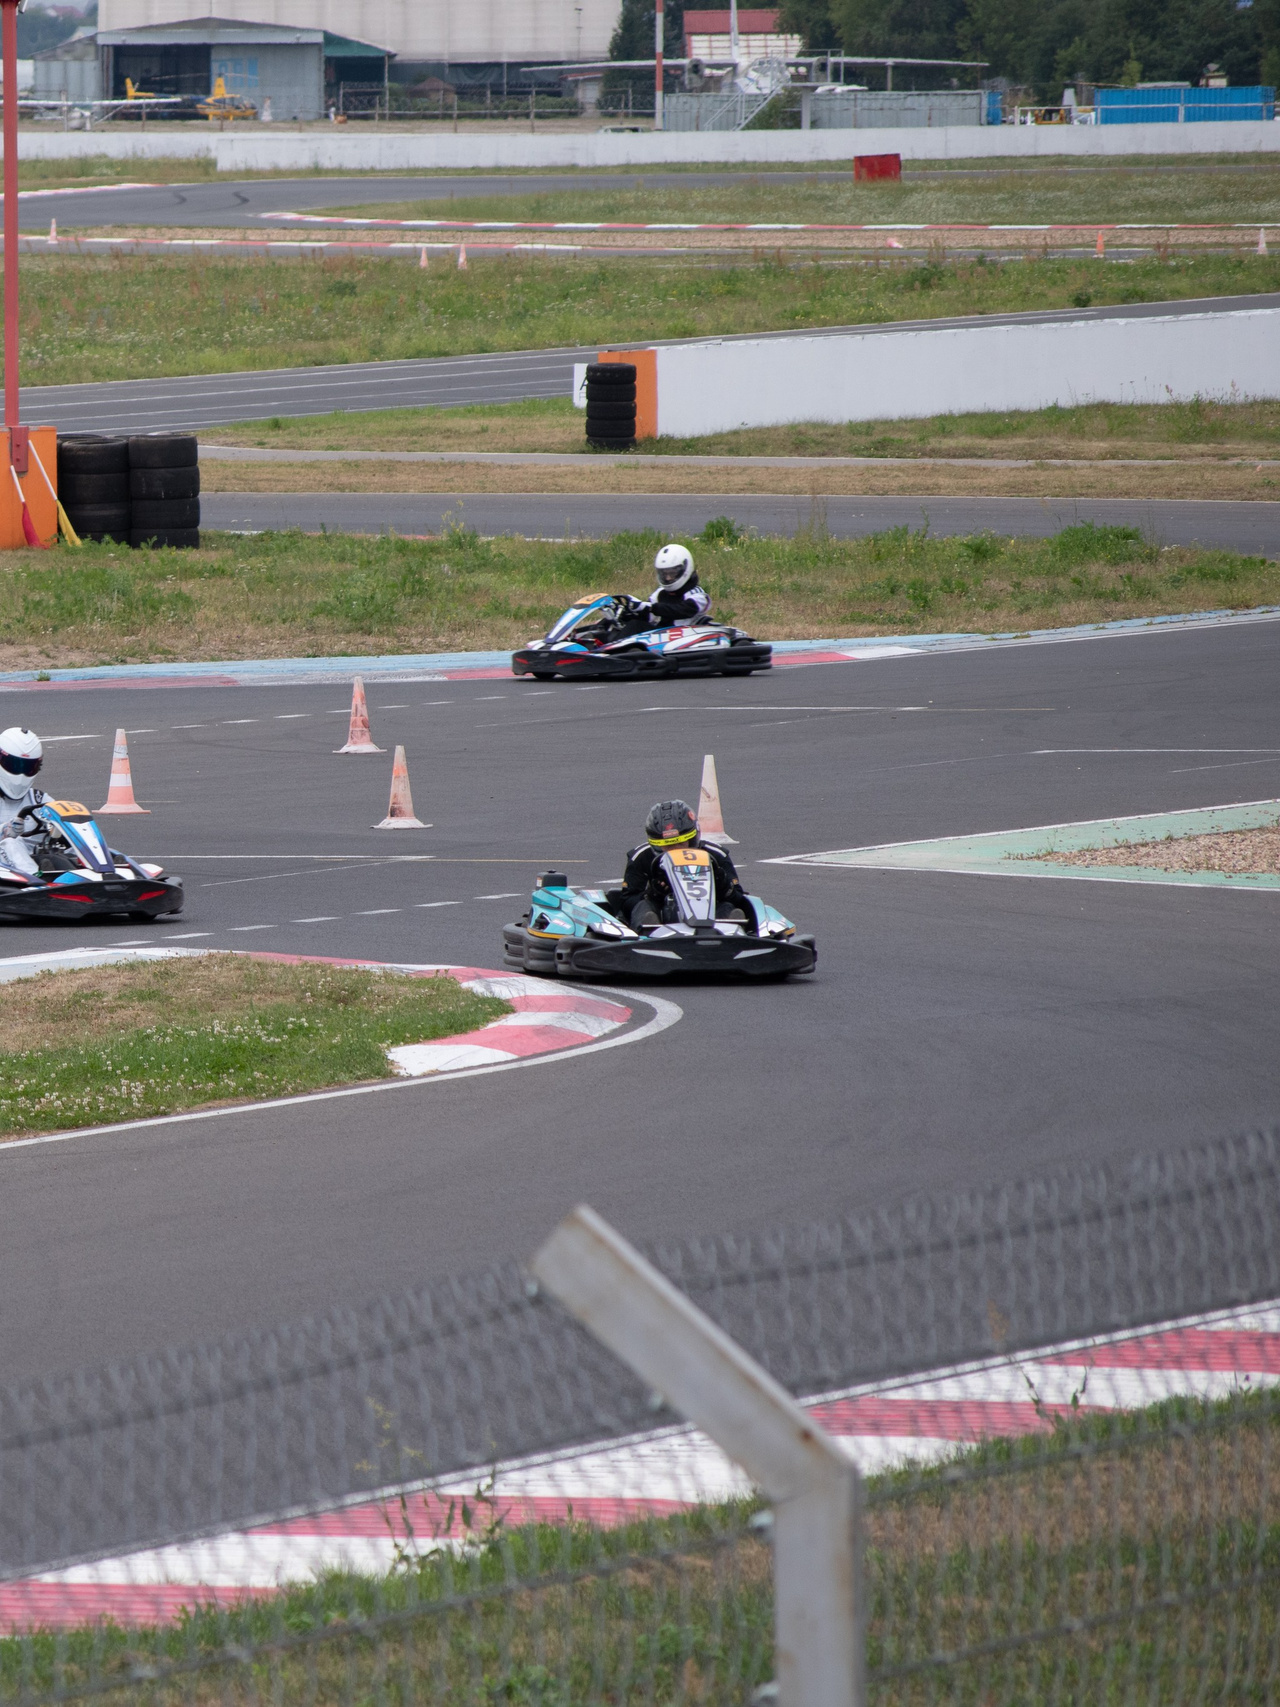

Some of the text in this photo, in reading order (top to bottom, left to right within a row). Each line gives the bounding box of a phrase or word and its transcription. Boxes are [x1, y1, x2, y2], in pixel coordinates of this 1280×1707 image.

[56, 802, 84, 813] 15
[682, 850, 697, 861] 5
[686, 881, 708, 898] 5
